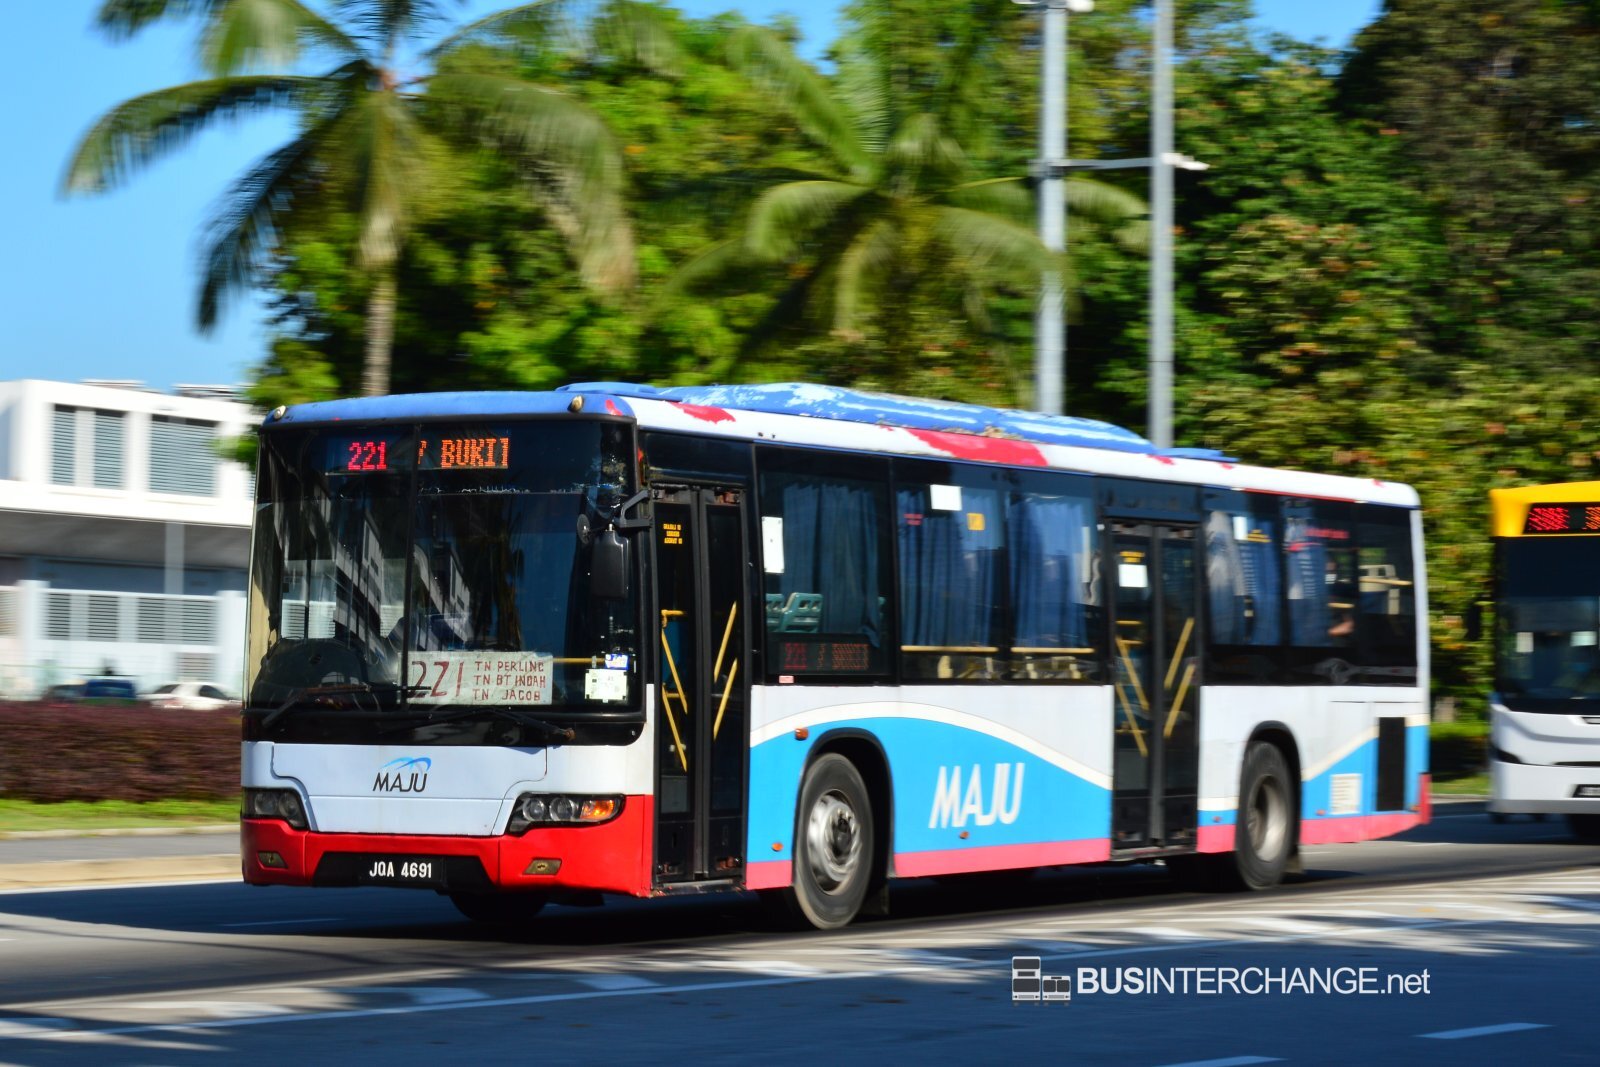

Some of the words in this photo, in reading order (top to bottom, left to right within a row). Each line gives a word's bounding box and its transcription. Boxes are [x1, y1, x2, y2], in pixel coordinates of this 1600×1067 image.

[348, 441, 387, 470] 221
[475, 660, 491, 671] TN
[405, 660, 464, 698] 221
[474, 674, 491, 685] TN
[496, 674, 511, 686] BT
[472, 689, 489, 700] TN
[502, 689, 541, 701] JACOB
[372, 772, 427, 792] MAJU
[928, 762, 1025, 829] MAJU
[369, 861, 395, 878] JQA
[400, 861, 432, 879] 4691
